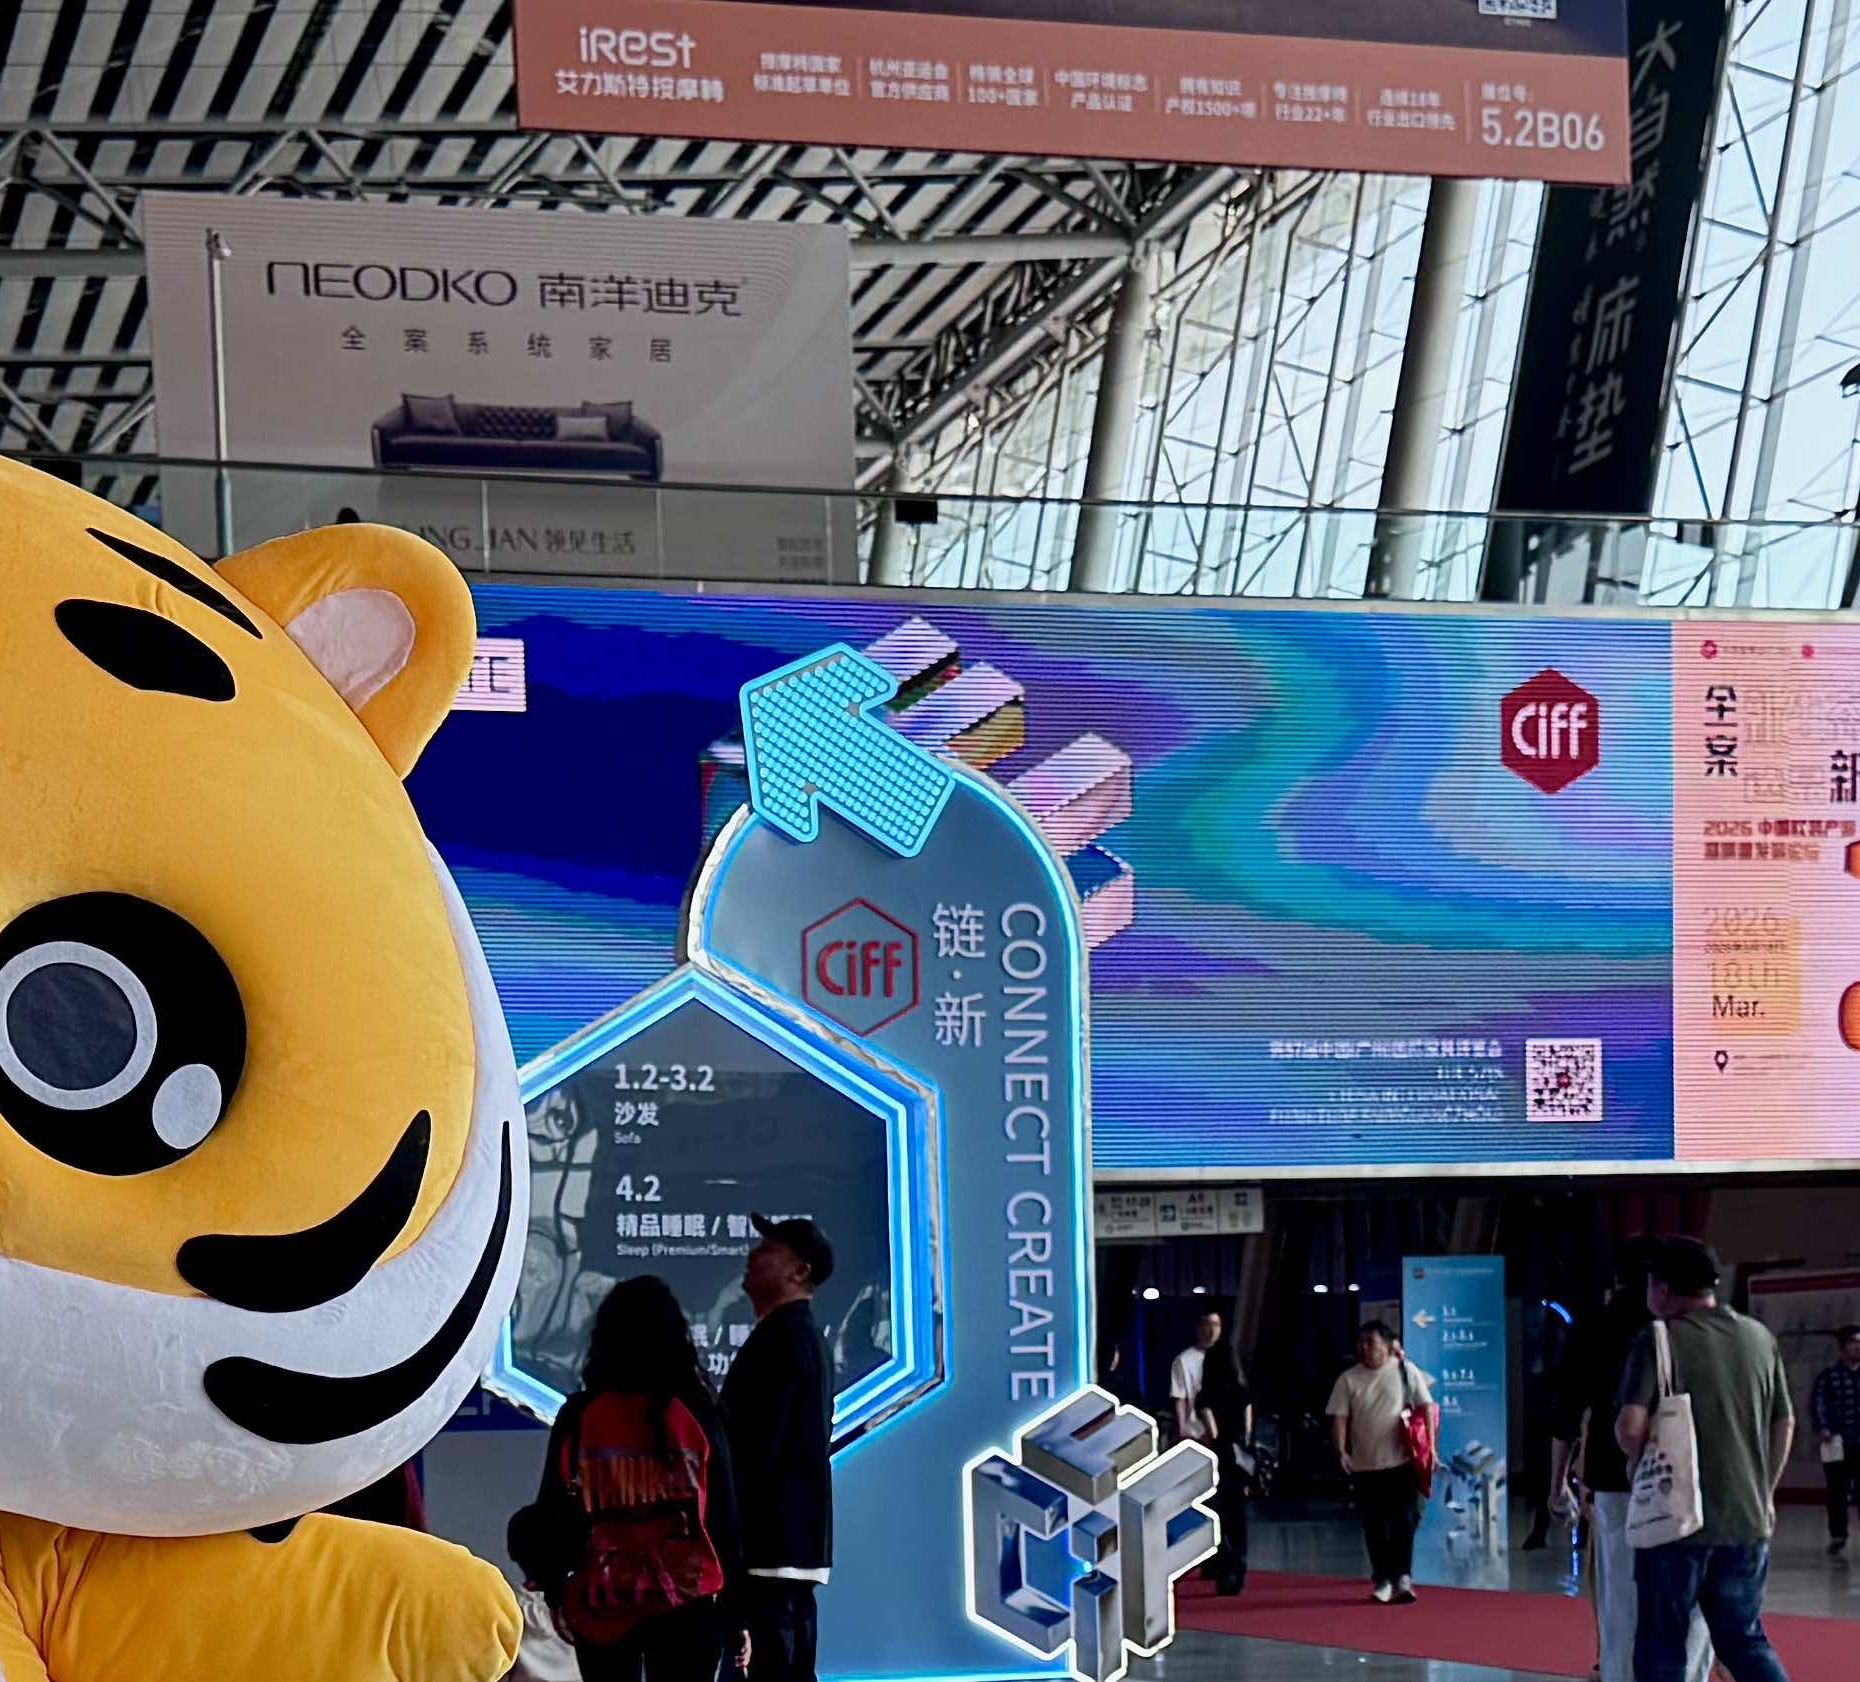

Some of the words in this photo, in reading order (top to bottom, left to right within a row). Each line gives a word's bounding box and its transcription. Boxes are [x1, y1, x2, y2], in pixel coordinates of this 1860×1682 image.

[1482, 107, 1606, 151] 5.2B06
[265, 261, 518, 307] NEODKO
[537, 272, 743, 318] 南洋迪克
[341, 325, 673, 363] 全案系统家居
[1712, 995, 1767, 1018] Mar.
[1001, 902, 1051, 1175] CONNECT
[614, 1063, 716, 1092] 1.2-3.2
[614, 1101, 660, 1127] 沙发
[614, 1132, 642, 1144] Sofa
[615, 1174, 662, 1202] 4.2
[616, 1213, 706, 1238] 精品睡眠
[616, 1244, 649, 1258] Sleep
[1005, 1191, 1056, 1401] CREATE
